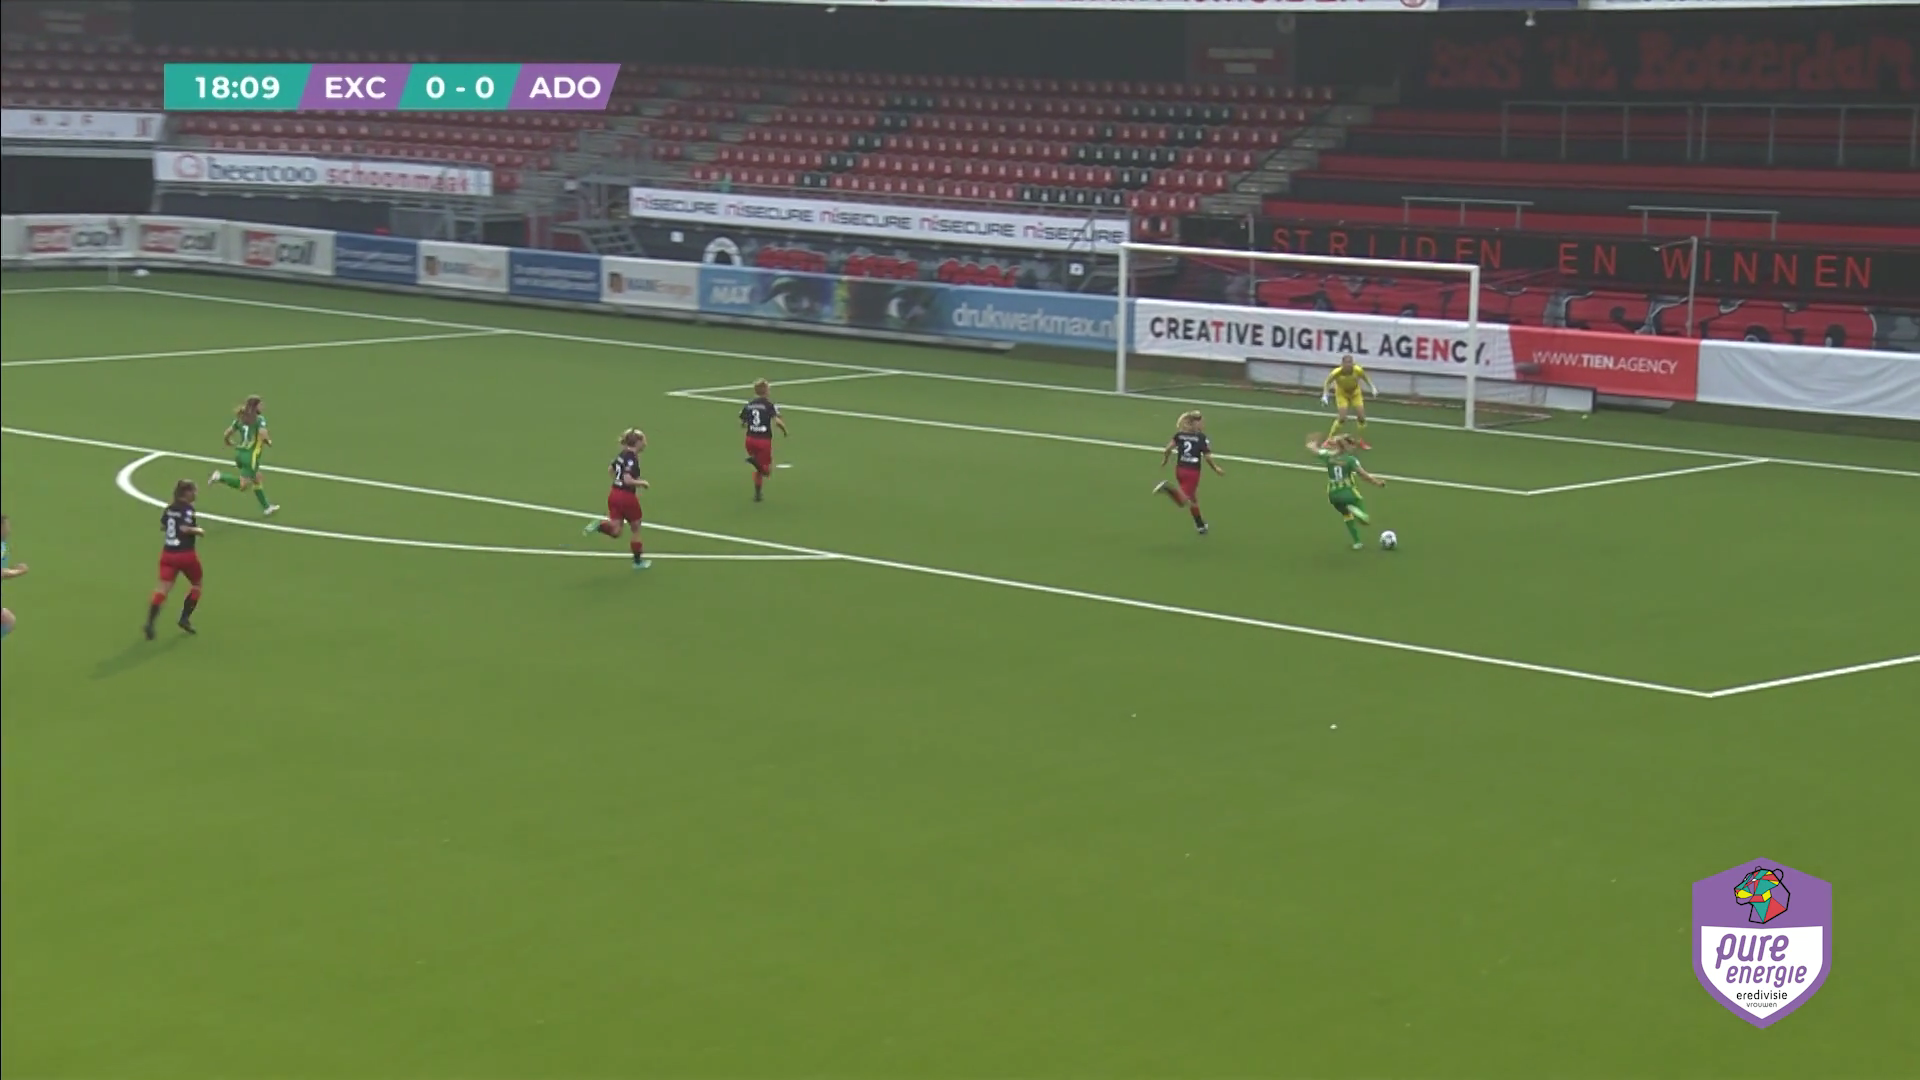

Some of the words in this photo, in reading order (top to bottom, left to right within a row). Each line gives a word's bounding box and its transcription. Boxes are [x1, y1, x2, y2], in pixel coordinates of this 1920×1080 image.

[1557, 242, 1618, 276] EN
[1661, 248, 1872, 289] WINNEN
[952, 303, 1118, 337] drukwerkmax.nl
[1150, 316, 1265, 347] CREATIVE
[1272, 326, 1369, 355] DIGITAL
[752, 409, 761, 426] 3
[1183, 440, 1193, 457] 2
[166, 517, 177, 538] 8
